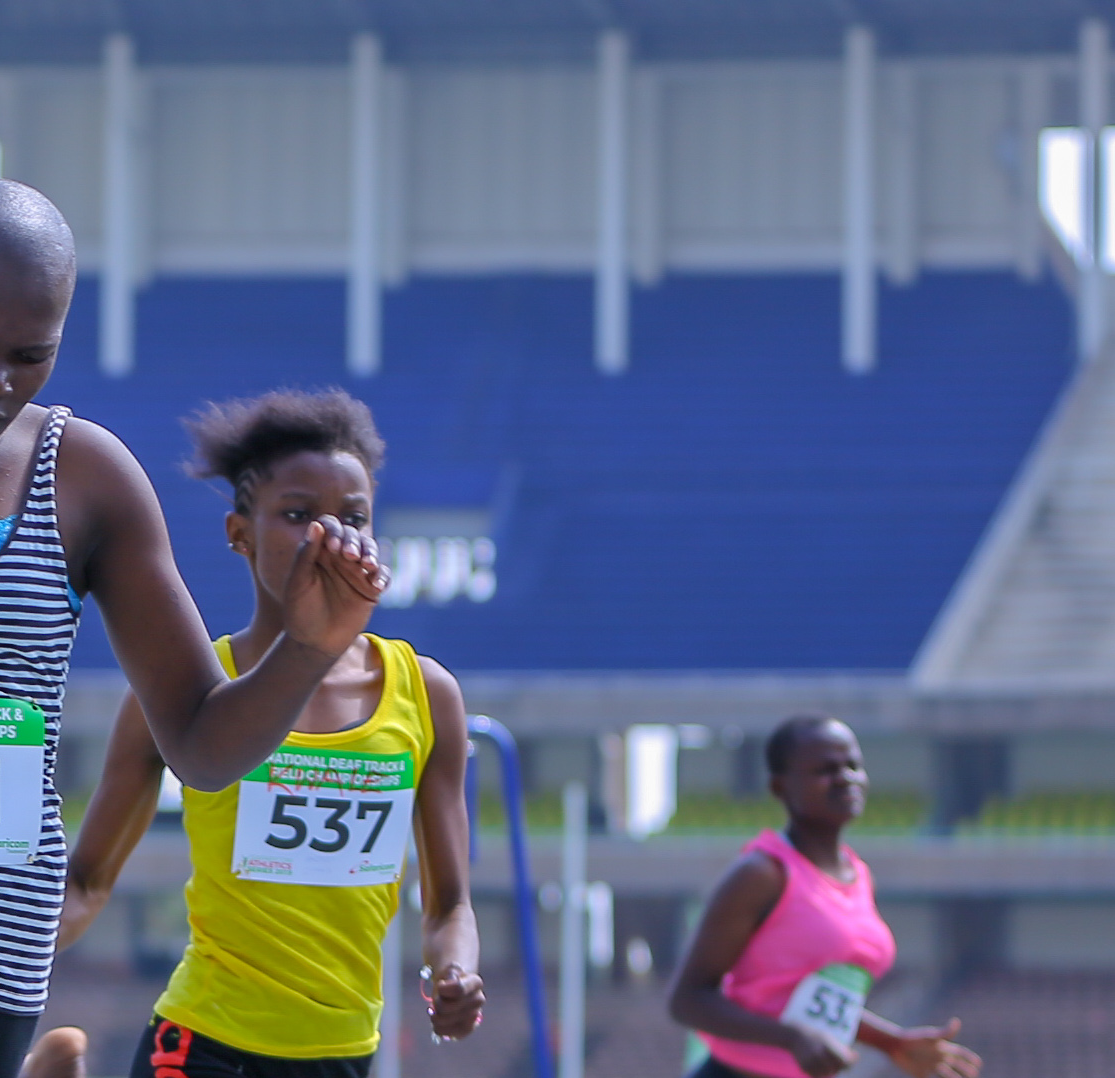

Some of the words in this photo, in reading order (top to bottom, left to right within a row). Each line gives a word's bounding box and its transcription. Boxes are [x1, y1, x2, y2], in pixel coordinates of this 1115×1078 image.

[13, 707, 25, 722] &
[328, 757, 362, 769] DEAF
[364, 760, 399, 772] TRACK
[271, 767, 304, 781] FIELD
[306, 770, 402, 786] CHAMPIONSHIPS
[265, 794, 394, 854] 537
[805, 984, 854, 1032] 53
